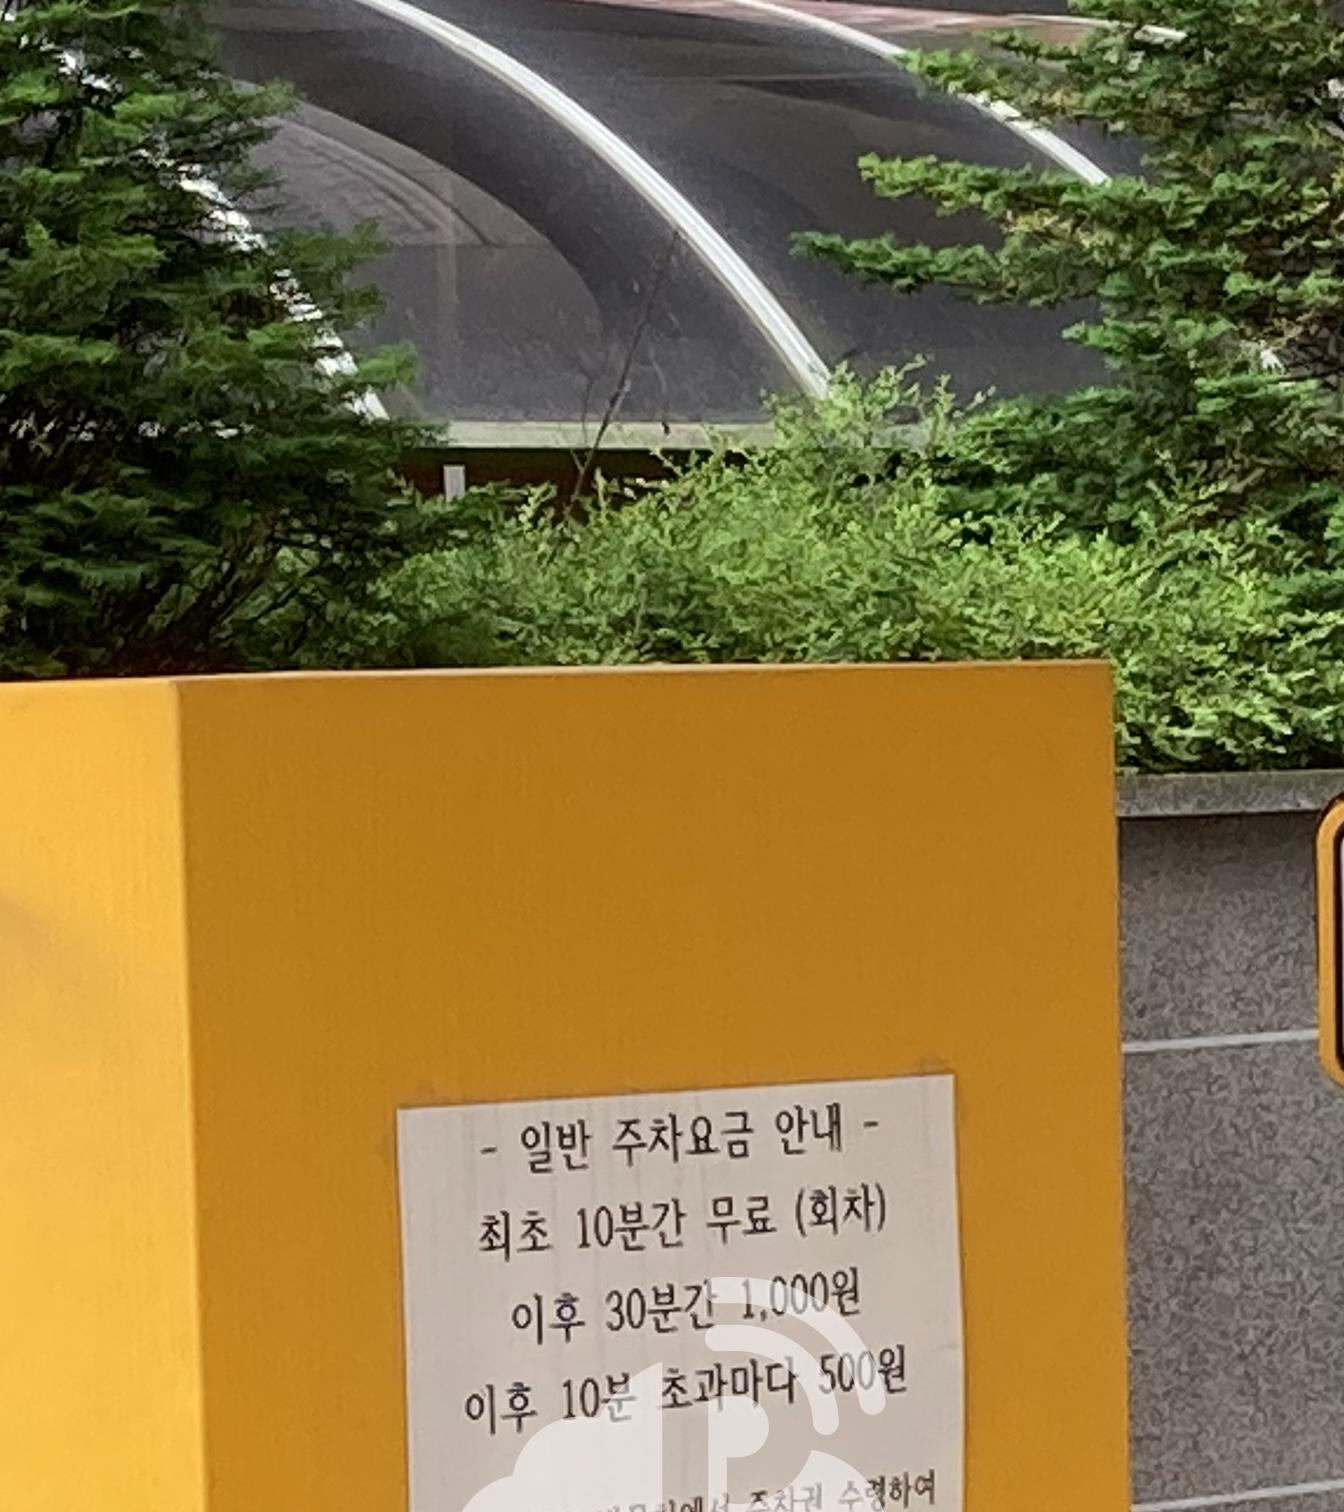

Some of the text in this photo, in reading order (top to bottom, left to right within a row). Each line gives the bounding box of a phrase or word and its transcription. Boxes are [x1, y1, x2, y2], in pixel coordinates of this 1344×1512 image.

[519, 1119, 592, 1174] 일반
[611, 1110, 756, 1166] 주차요금
[775, 1101, 843, 1157] 안내
[478, 1182, 887, 1262] 최초 10분간 무료 (회차)
[511, 1265, 861, 1346] 이후 30분간 1,000원
[464, 1343, 909, 1436] 이후 10분 초과마다 500원
